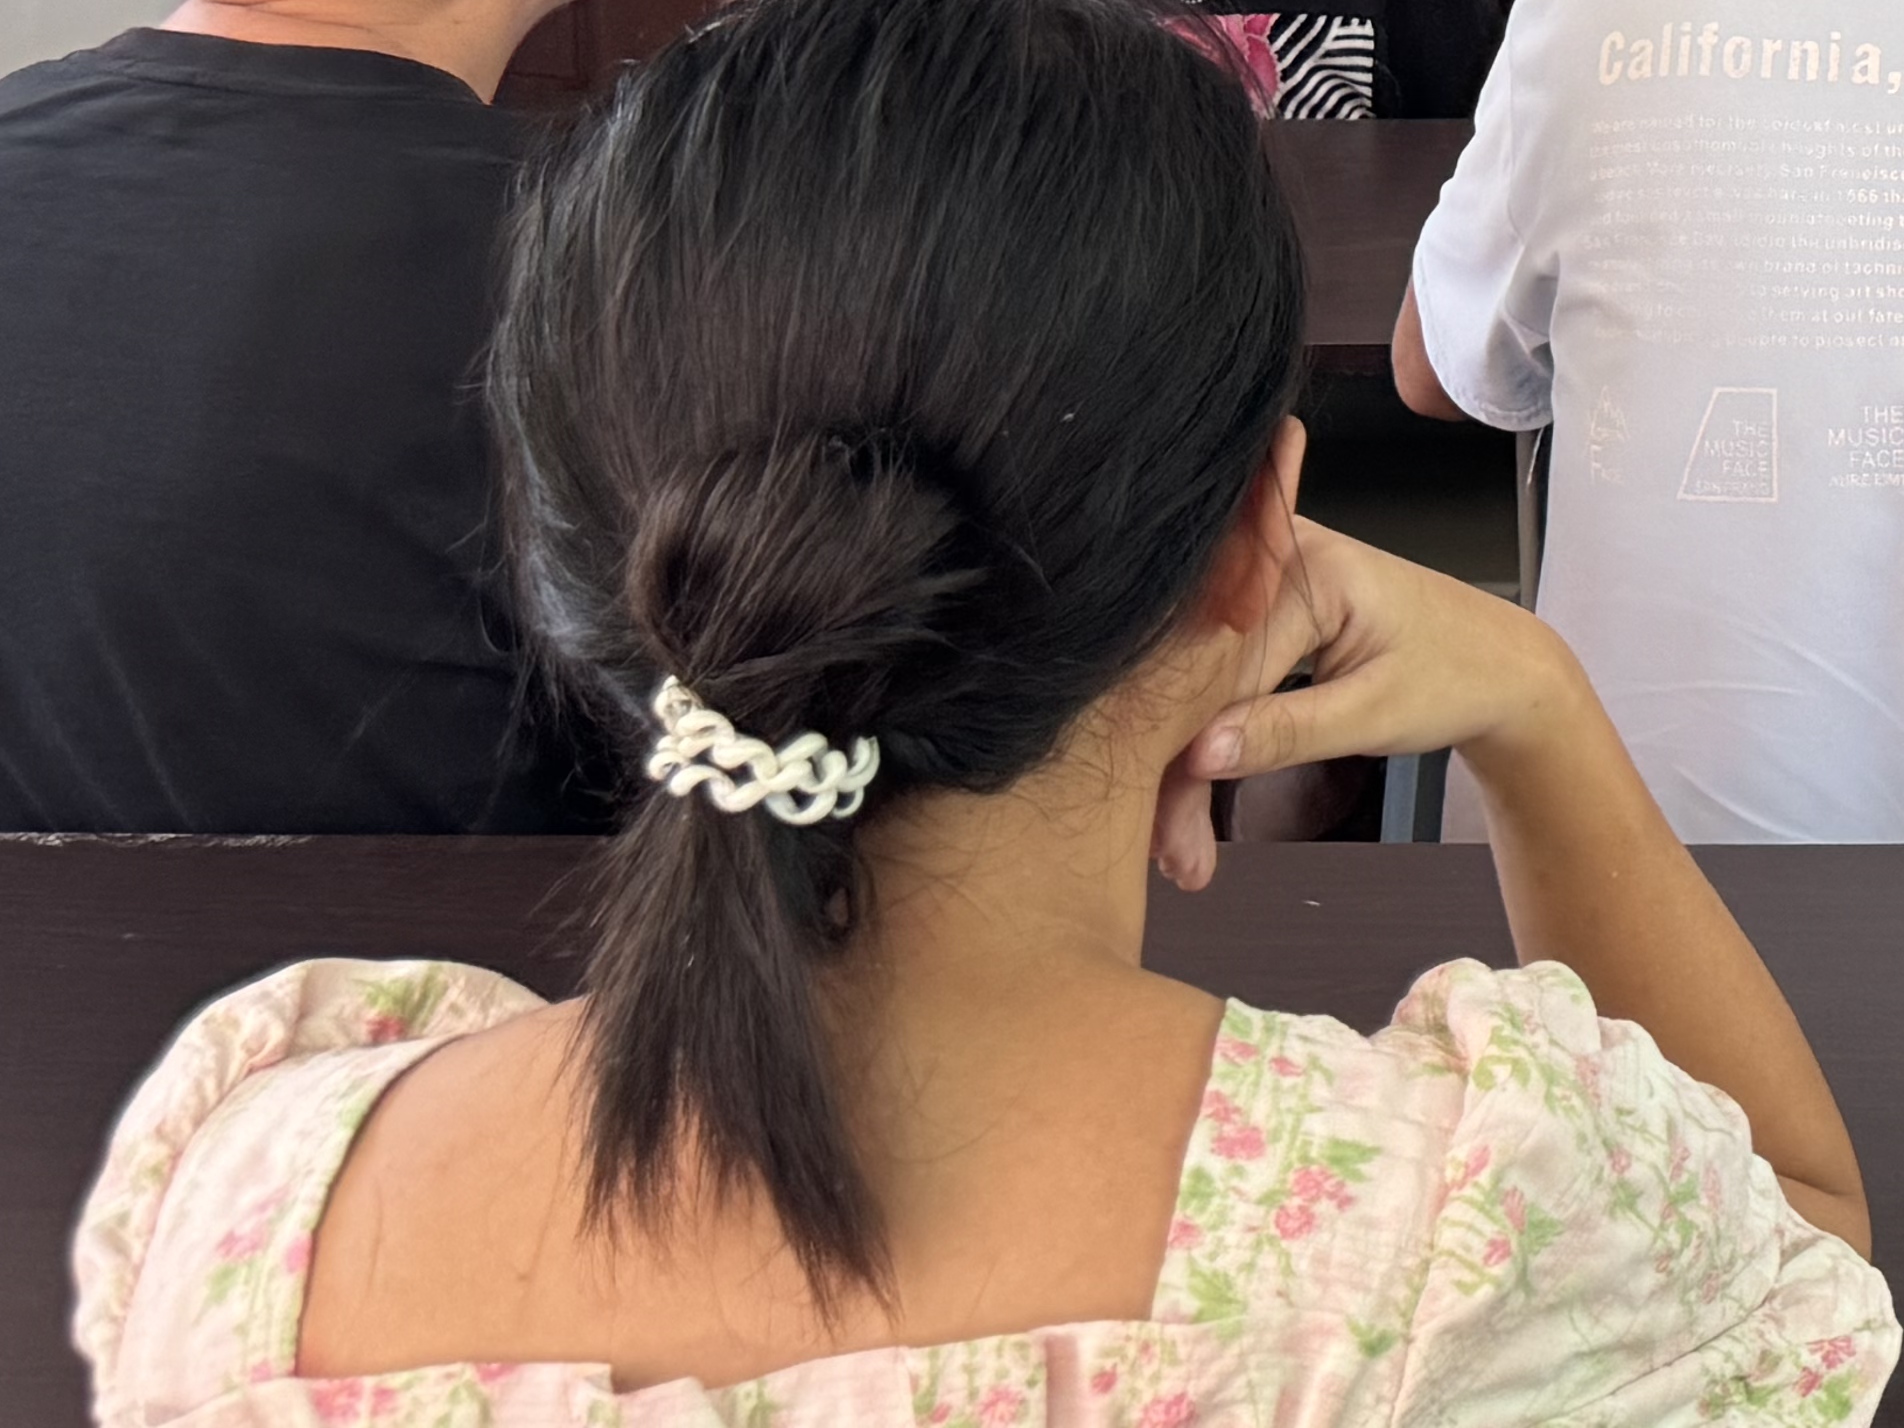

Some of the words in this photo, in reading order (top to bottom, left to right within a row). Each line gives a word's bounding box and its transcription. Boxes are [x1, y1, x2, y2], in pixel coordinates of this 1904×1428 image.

[1861, 404, 1904, 424] THE
[1732, 419, 1770, 438] THE
[1827, 426, 1904, 448] MUSIC
[1703, 439, 1769, 458] MUSIC
[1722, 459, 1770, 477] FACE
